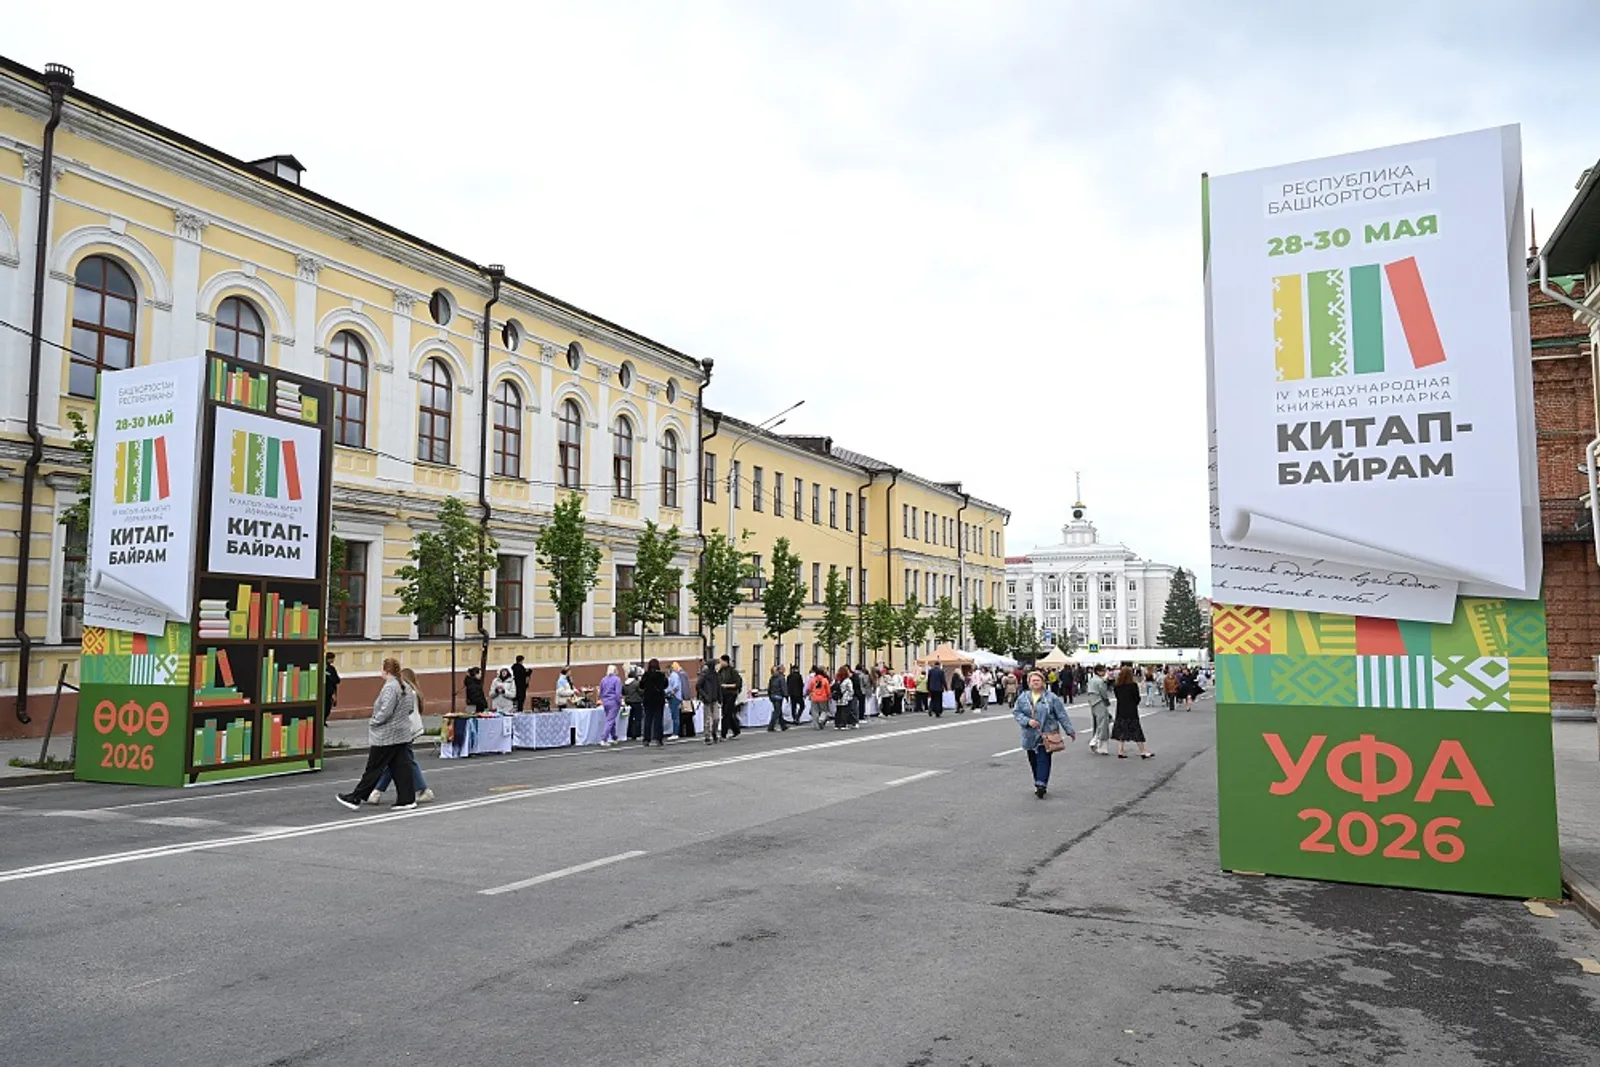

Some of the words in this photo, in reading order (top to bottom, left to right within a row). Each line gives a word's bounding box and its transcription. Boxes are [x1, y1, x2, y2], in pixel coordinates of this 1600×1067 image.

[1268, 178, 1431, 214] БАШКОРТОСТАН
[1282, 165, 1414, 197] РЕСПУБЛИКА
[1267, 228, 1351, 257] 28-30
[1364, 214, 1438, 244] МАЯ
[1276, 398, 1358, 413] КНИЖНАЯ
[1368, 390, 1452, 406] ЯРМАРКА
[1298, 376, 1451, 398] МЕЖДУНАРОДНАЯ
[115, 416, 145, 431] 28-30
[147, 408, 174, 427] МАЙ
[1276, 411, 1473, 453] КИТАП-
[1278, 452, 1454, 485] БАЙРАМ
[110, 524, 174, 546] КИТАП-
[227, 517, 309, 541] КИТАП-
[109, 546, 167, 565] БАЙРАМ
[226, 539, 301, 560] БАЙРАМ
[93, 699, 169, 736] ӨФӨ
[101, 742, 155, 771] 2026
[1262, 733, 1495, 807] УФА
[1297, 808, 1465, 863] 2026
